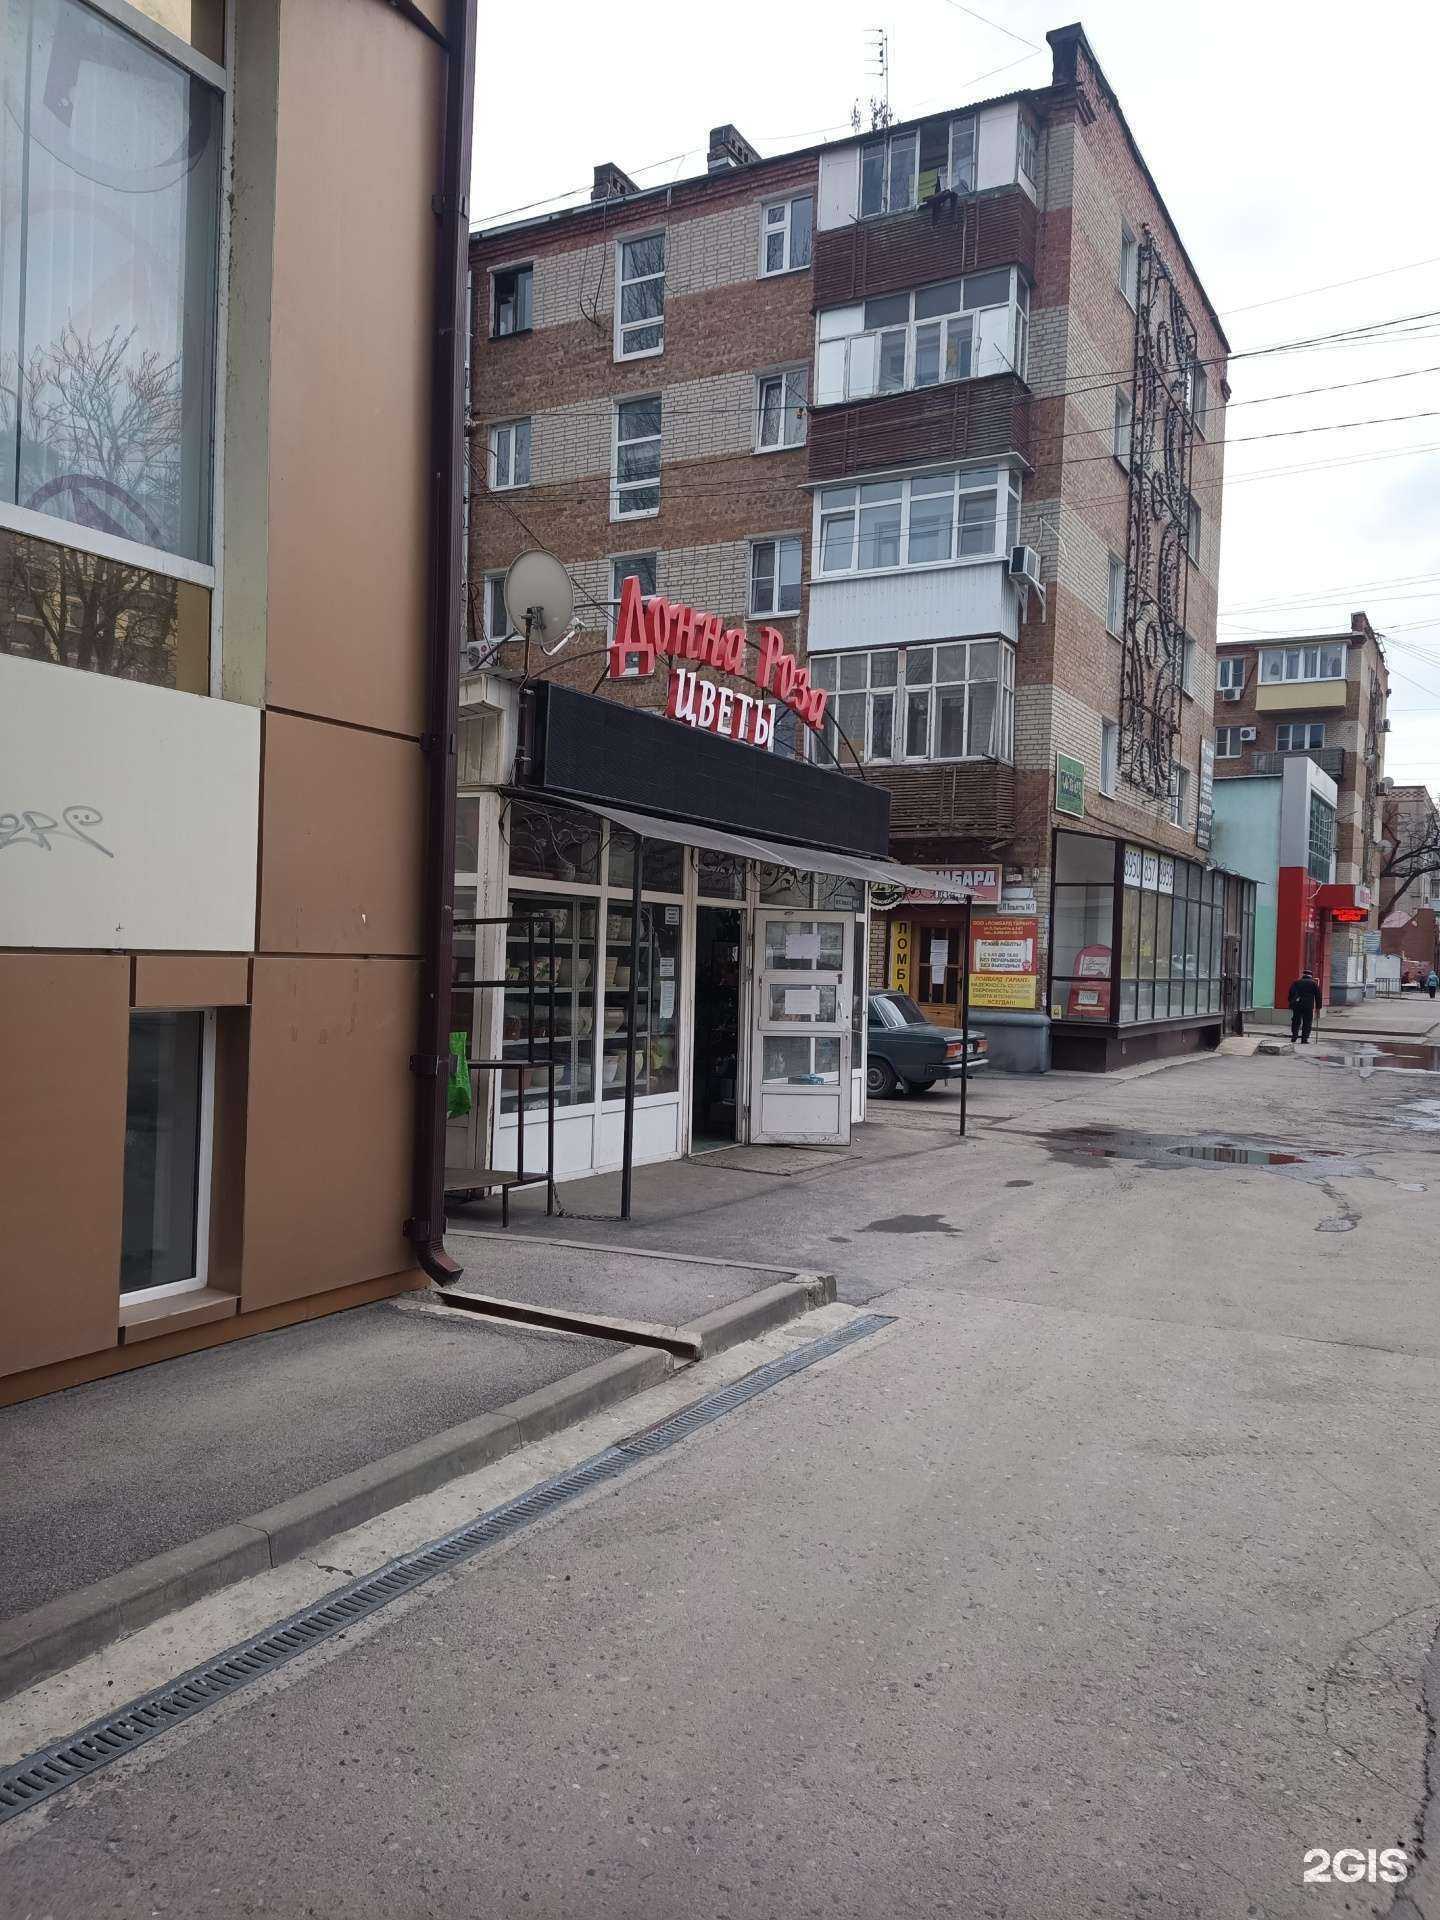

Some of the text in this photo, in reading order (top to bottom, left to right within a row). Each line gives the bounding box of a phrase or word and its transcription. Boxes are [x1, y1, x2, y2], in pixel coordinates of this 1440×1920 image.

[609, 575, 828, 730] Донна Роза
[670, 668, 776, 752] ЦВЕТЫ
[896, 922, 908, 993] ЛОМБА
